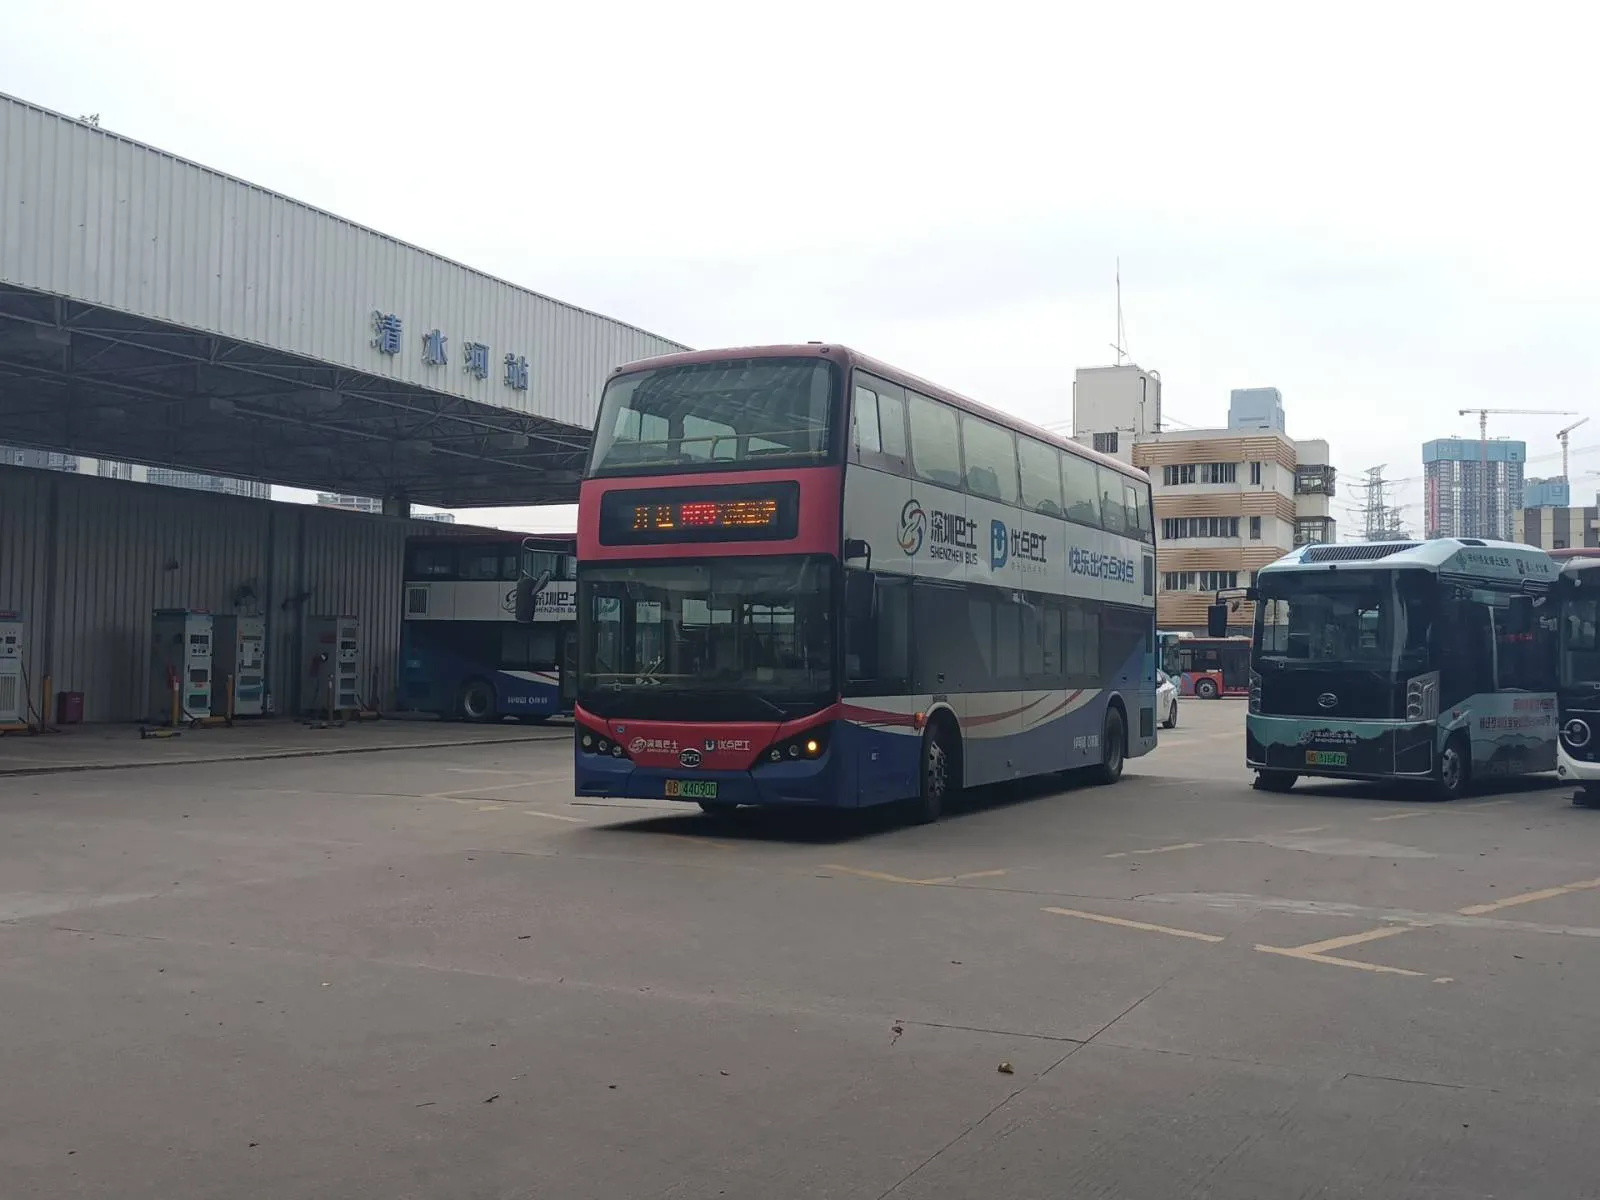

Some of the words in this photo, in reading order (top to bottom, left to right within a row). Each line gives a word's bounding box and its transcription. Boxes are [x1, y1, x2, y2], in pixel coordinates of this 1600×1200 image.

[368, 309, 529, 391] 清水河站
[931, 510, 977, 549] 深圳巴士
[1011, 528, 1047, 563] 优点巴士
[931, 546, 963, 563] SHENZHEN
[965, 552, 978, 565] BUS
[1068, 546, 1135, 584] 快乐出行点对点
[681, 753, 700, 762] BYD
